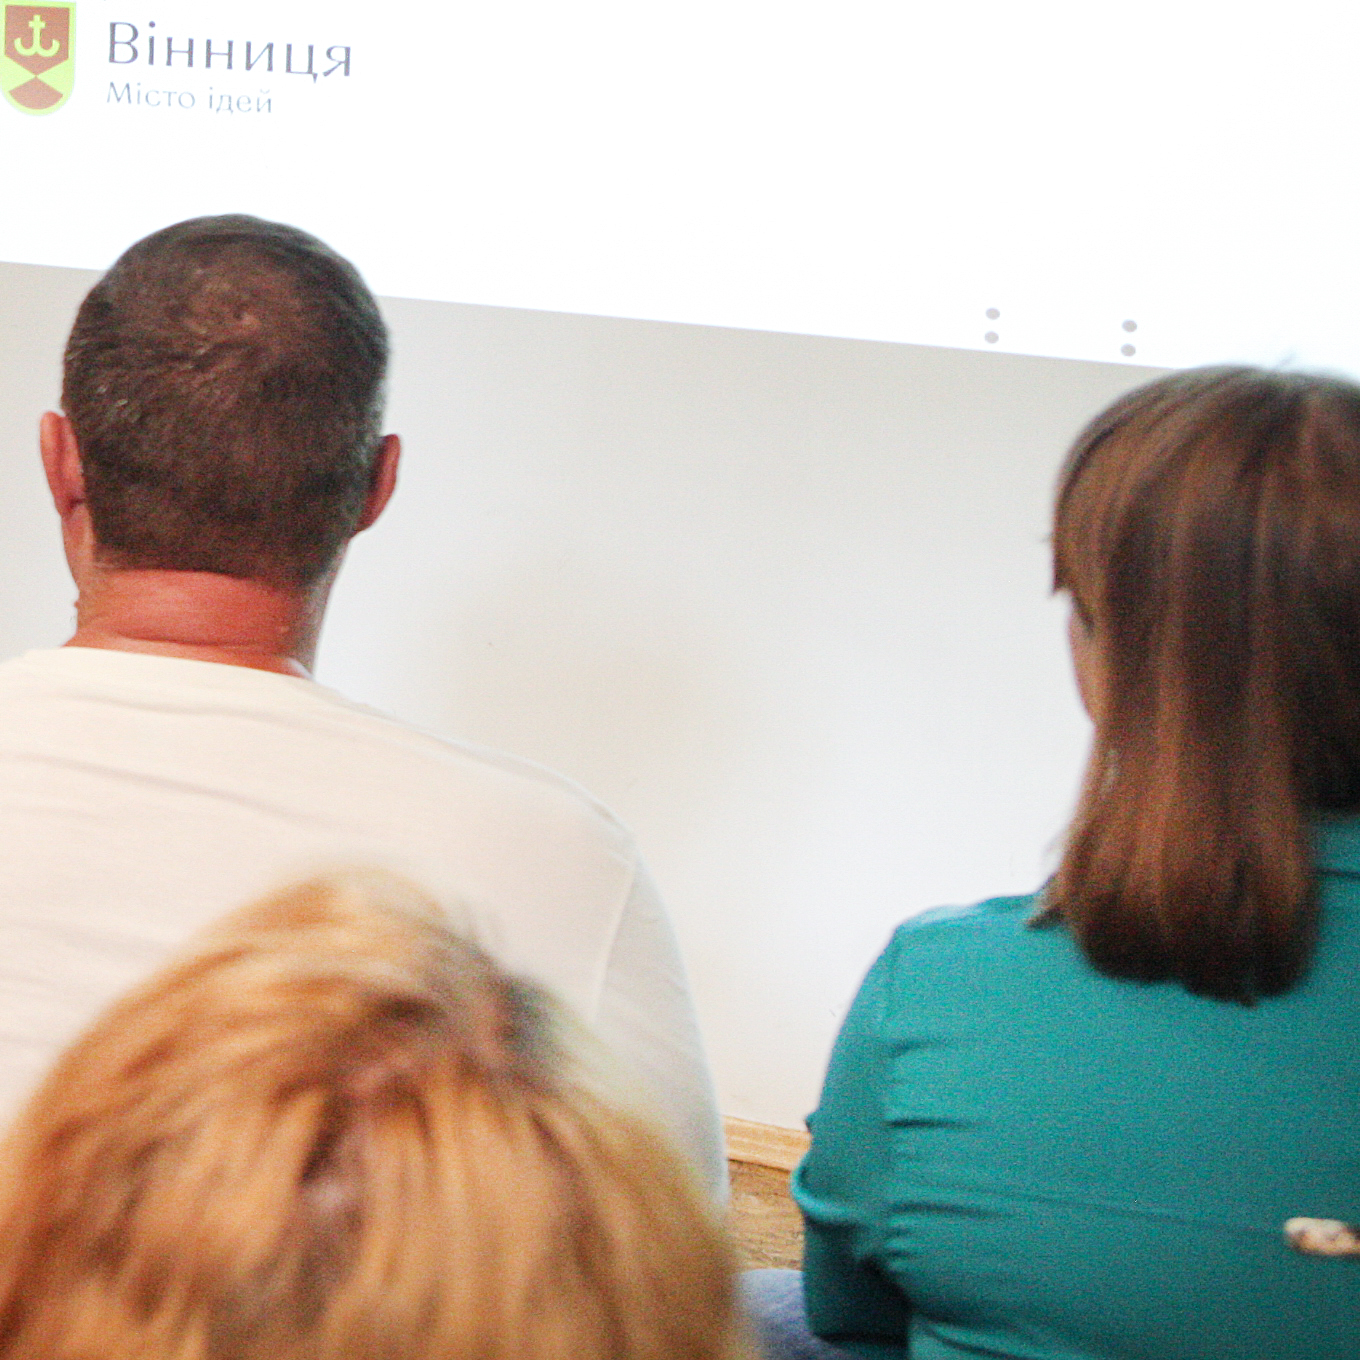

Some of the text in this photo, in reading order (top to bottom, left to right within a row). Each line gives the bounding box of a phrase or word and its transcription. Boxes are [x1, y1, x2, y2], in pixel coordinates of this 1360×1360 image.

[107, 21, 352, 86] Вінниця
[106, 81, 273, 115] Місто ідей
